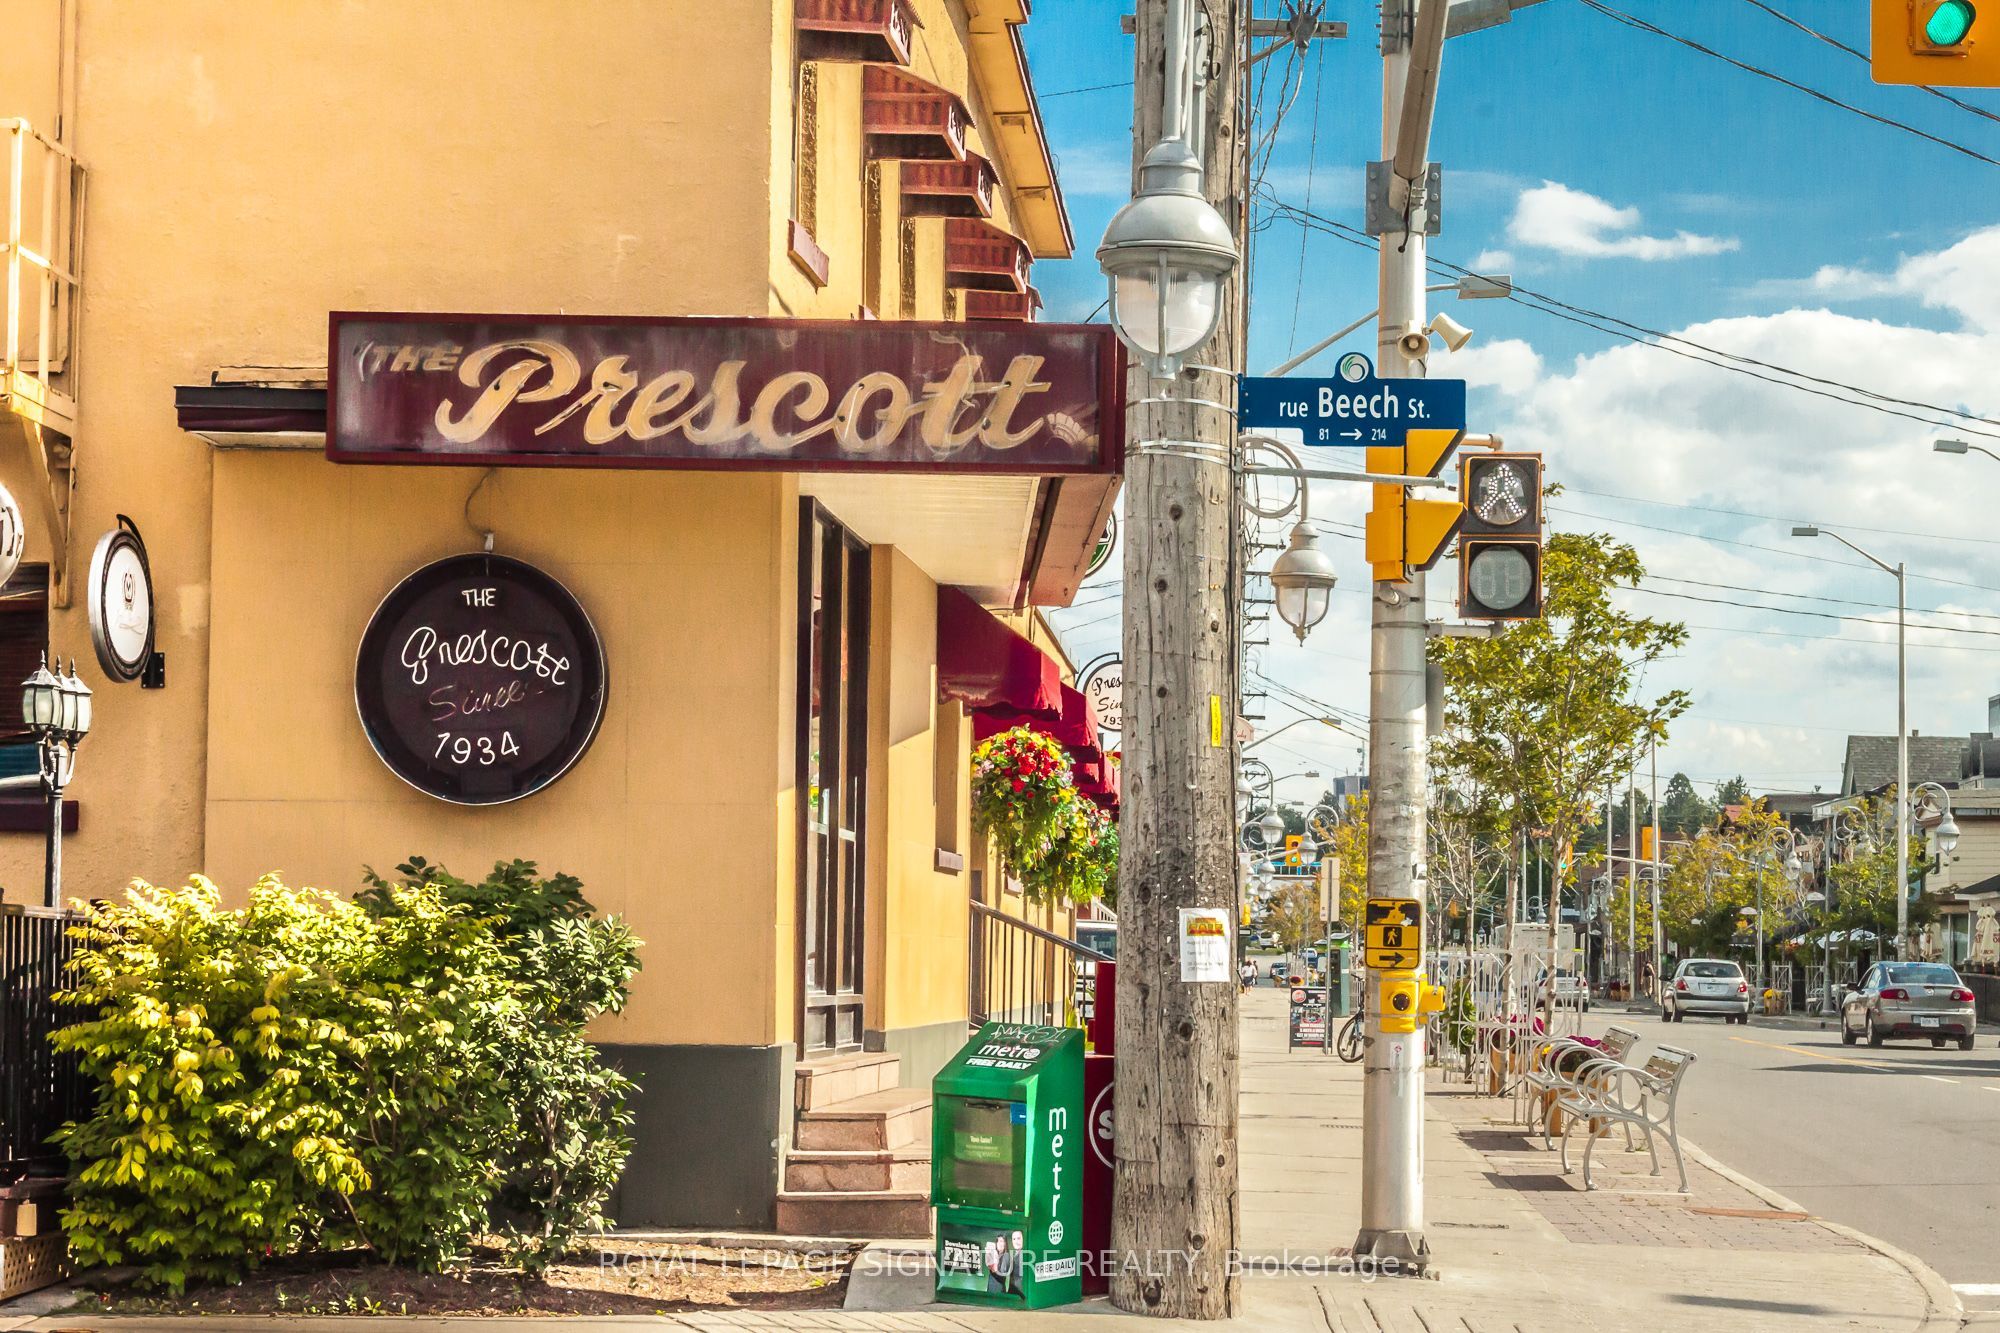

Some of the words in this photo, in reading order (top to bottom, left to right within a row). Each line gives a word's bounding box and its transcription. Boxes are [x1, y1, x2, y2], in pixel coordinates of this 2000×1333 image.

[370, 345, 463, 374] THE
[435, 339, 1052, 453] Prescott
[1279, 402, 1309, 417] rue
[1318, 385, 1399, 418] Beech
[1408, 398, 1431, 418] St.
[1318, 428, 1329, 441] 81
[1371, 428, 1387, 441] 214
[462, 588, 497, 607] THE
[401, 627, 570, 684] Prescott
[1092, 677, 1122, 696] Pres
[1097, 697, 1122, 712] Sin
[1103, 715, 1122, 725] 193
[434, 731, 520, 765] 1934
[966, 1058, 996, 1067] FREE
[995, 1060, 1031, 1070] DAILY
[944, 1247, 981, 1264] FREE
[1036, 1263, 1053, 1274] FREE
[1055, 1259, 1075, 1271] DAILY
